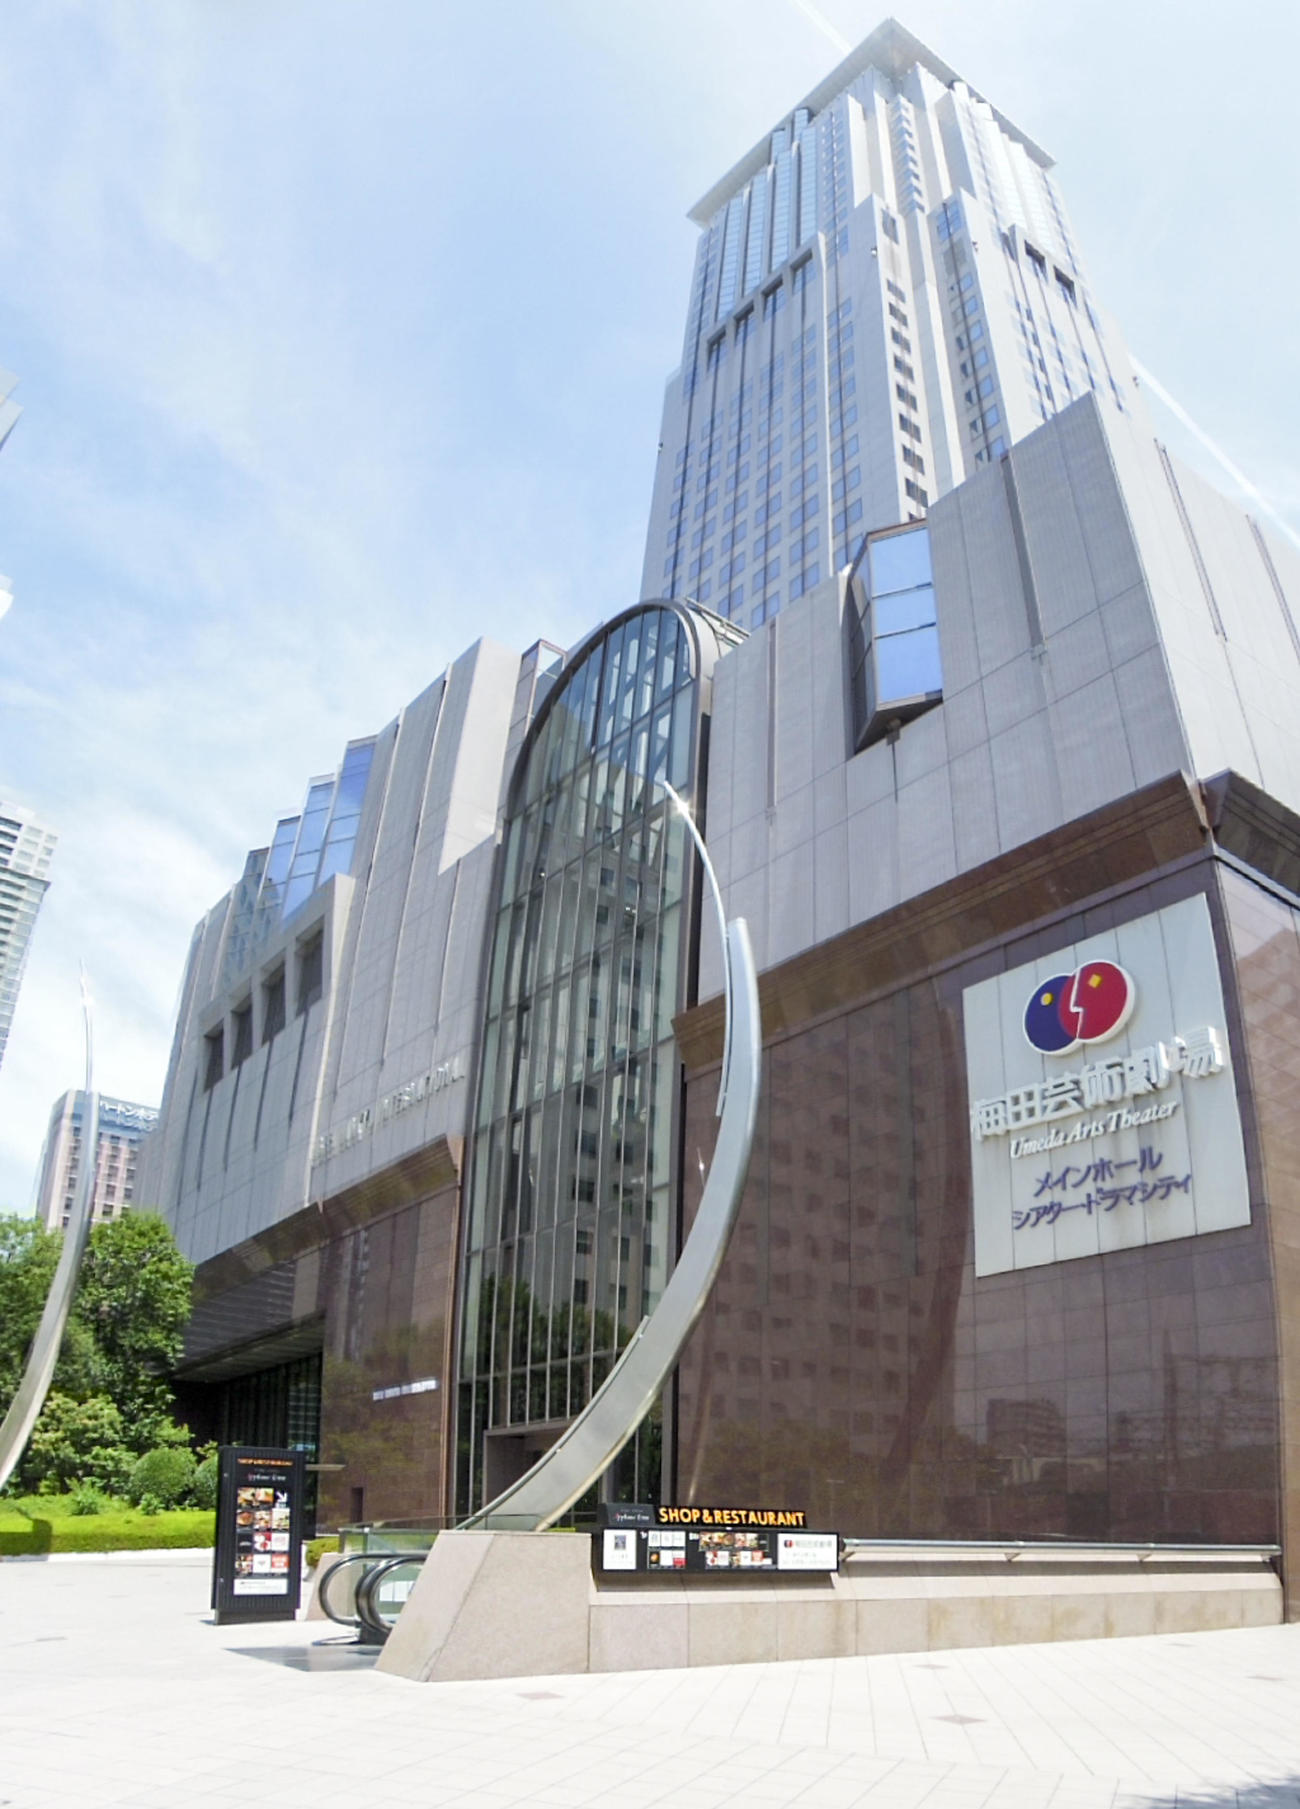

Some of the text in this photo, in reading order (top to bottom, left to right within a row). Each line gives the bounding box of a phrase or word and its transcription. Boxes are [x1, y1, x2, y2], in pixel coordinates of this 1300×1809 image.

[973, 1026, 1224, 1140] 梅田芸術劇場
[1010, 1101, 1179, 1159] Umeda Arts Theater
[1033, 1145, 1163, 1197] メインホール
